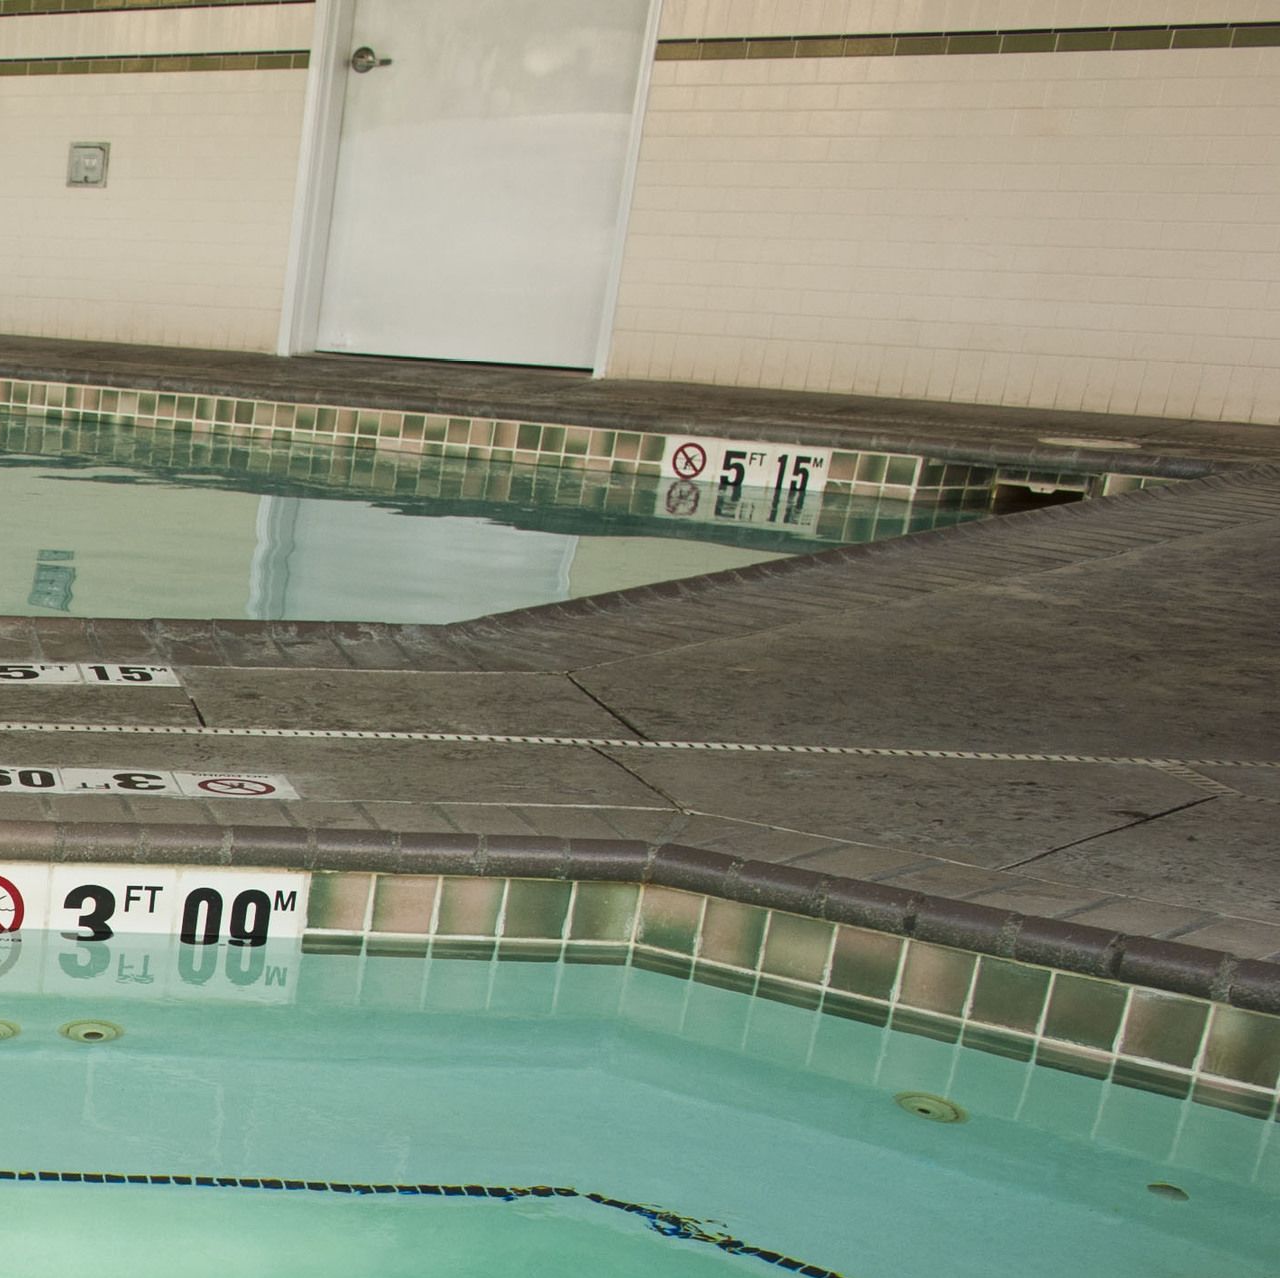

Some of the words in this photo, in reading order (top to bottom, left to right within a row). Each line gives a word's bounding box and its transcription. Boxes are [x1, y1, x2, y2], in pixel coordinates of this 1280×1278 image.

[719, 450, 747, 486] 5
[748, 452, 767, 466] FT
[112, 773, 166, 790] 3
[60, 884, 116, 942] 3
[124, 886, 163, 913] FT
[273, 890, 297, 912] M
